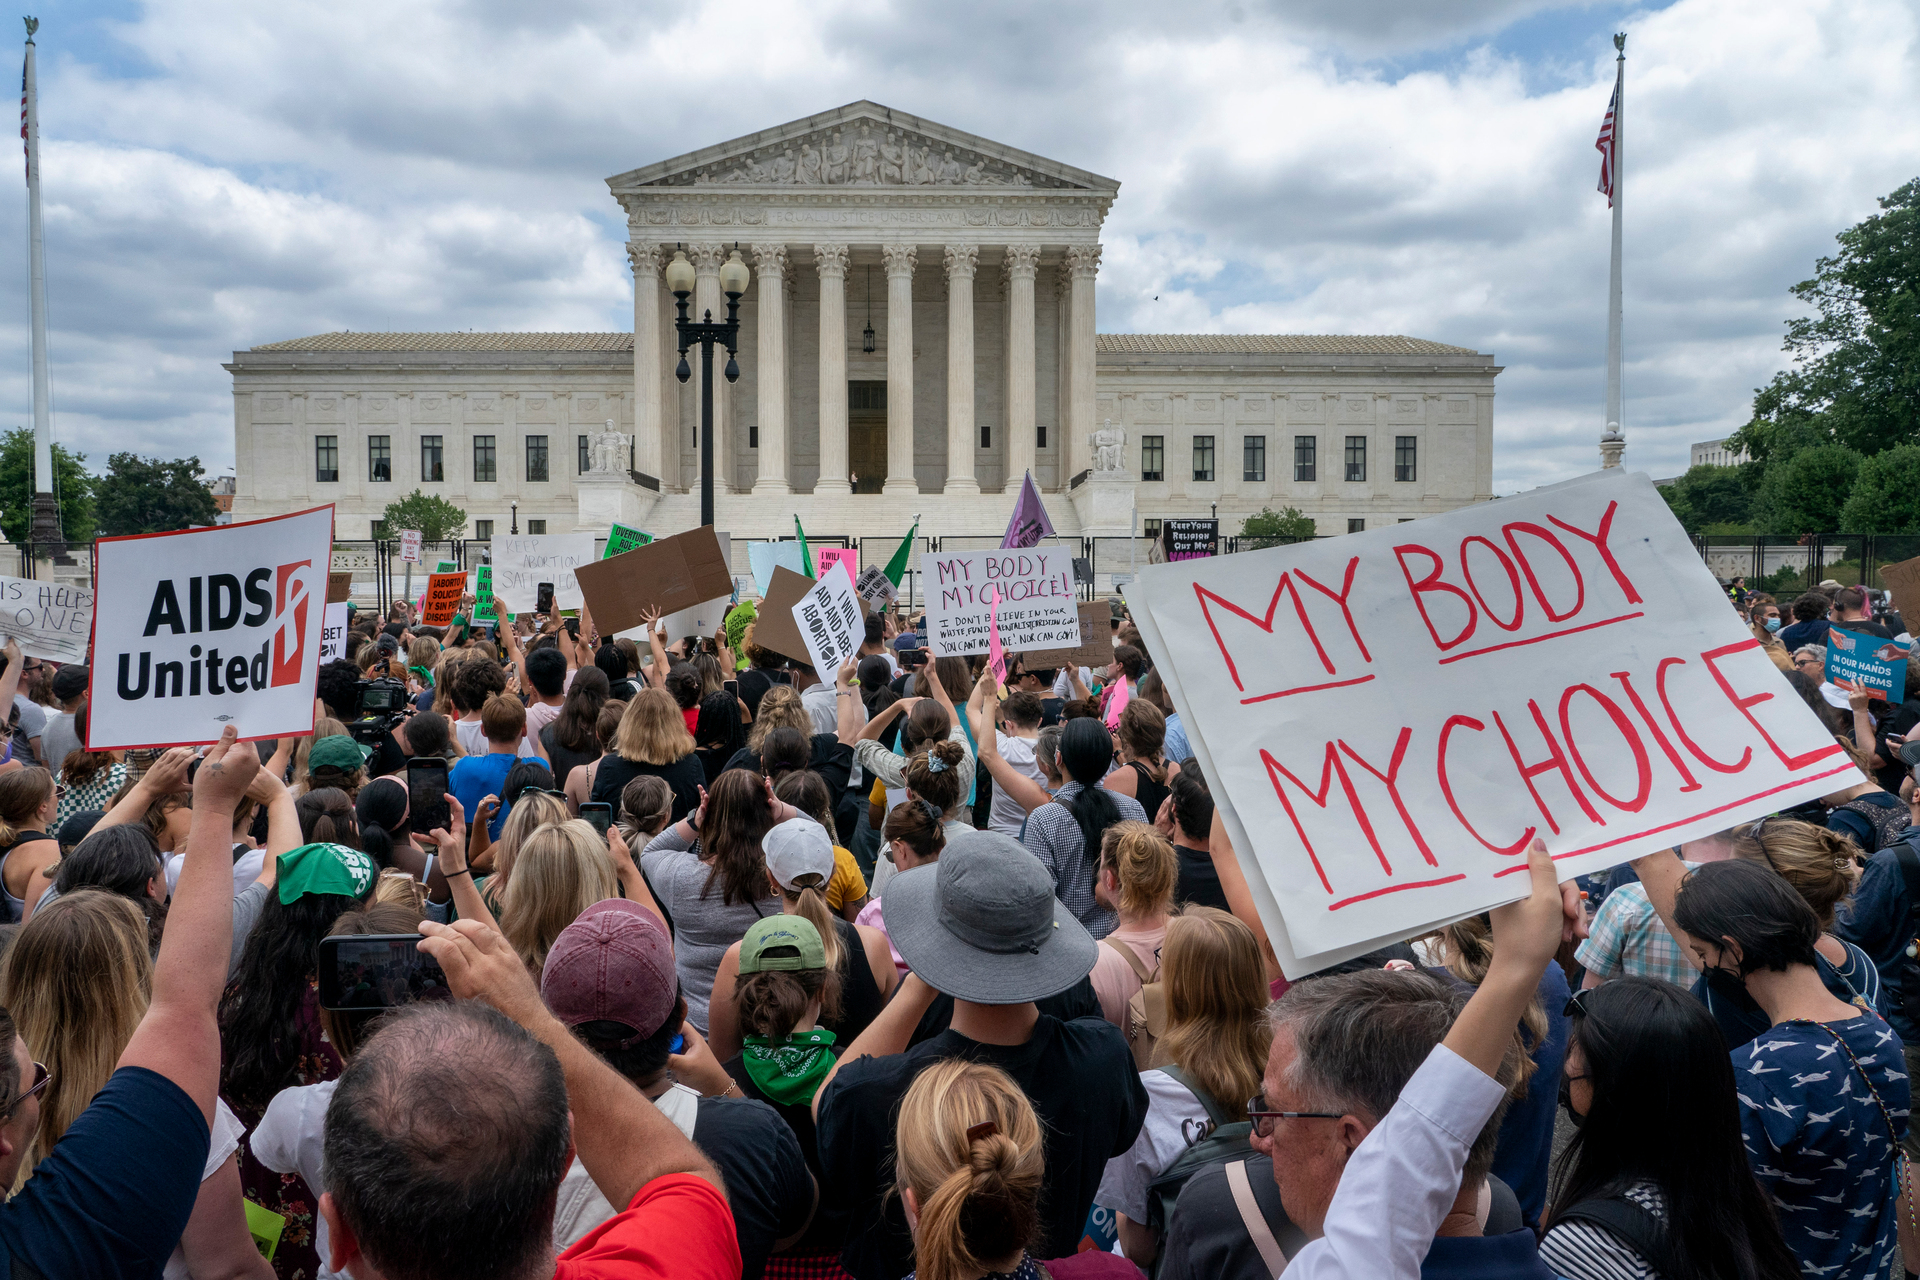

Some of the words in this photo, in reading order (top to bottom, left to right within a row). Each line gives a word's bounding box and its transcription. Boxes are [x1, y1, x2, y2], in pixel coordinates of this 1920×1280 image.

[776, 211, 821, 223] EQUAL
[822, 211, 874, 223] JUSTICE
[880, 211, 925, 223] UNDER
[928, 211, 954, 223] LAW
[403, 538, 418, 546] PARKING
[615, 526, 650, 544] OVERTURN
[505, 539, 539, 554] KEEP
[821, 551, 824, 560] I
[522, 554, 580, 569] ABORTION
[820, 562, 832, 570] AID
[937, 558, 973, 585] MY
[985, 554, 1048, 580] BODY
[433, 578, 460, 588] ¡ABORTO
[460, 577, 465, 585] A
[478, 582, 487, 591] ON
[502, 570, 540, 590] SAFE
[553, 573, 580, 590] LEGA
[39, 586, 94, 609] HELPS
[143, 567, 273, 637] AIDS
[428, 602, 434, 610] Y
[435, 601, 447, 610] SIN
[478, 595, 483, 603] &
[837, 590, 847, 602] I
[942, 584, 974, 610] MY
[1193, 556, 1372, 691] MY
[1393, 501, 1643, 651] BODY
[15, 607, 85, 634] ONE
[426, 612, 455, 622] DISCUL
[815, 585, 832, 608] AID
[824, 606, 843, 633] AND
[834, 630, 853, 658] ABET
[840, 596, 857, 630] WILL
[939, 619, 949, 628] I
[955, 615, 980, 627] DON'T
[1028, 610, 1040, 618] IN
[801, 604, 839, 671] ABORTION
[939, 641, 957, 653] YOU
[1019, 633, 1035, 645] NOR
[1037, 631, 1053, 641] CAN
[117, 638, 270, 701] United
[1832, 654, 1840, 663] IN
[1841, 657, 1857, 669] OUR
[1858, 662, 1892, 676] HANDS
[1831, 665, 1840, 675] ON
[1841, 669, 1857, 680] OUR
[1859, 673, 1893, 688] TERMS
[1260, 727, 1438, 894] MY
[1438, 638, 1844, 855] CHOICE
[1091, 1206, 1117, 1239] ON
